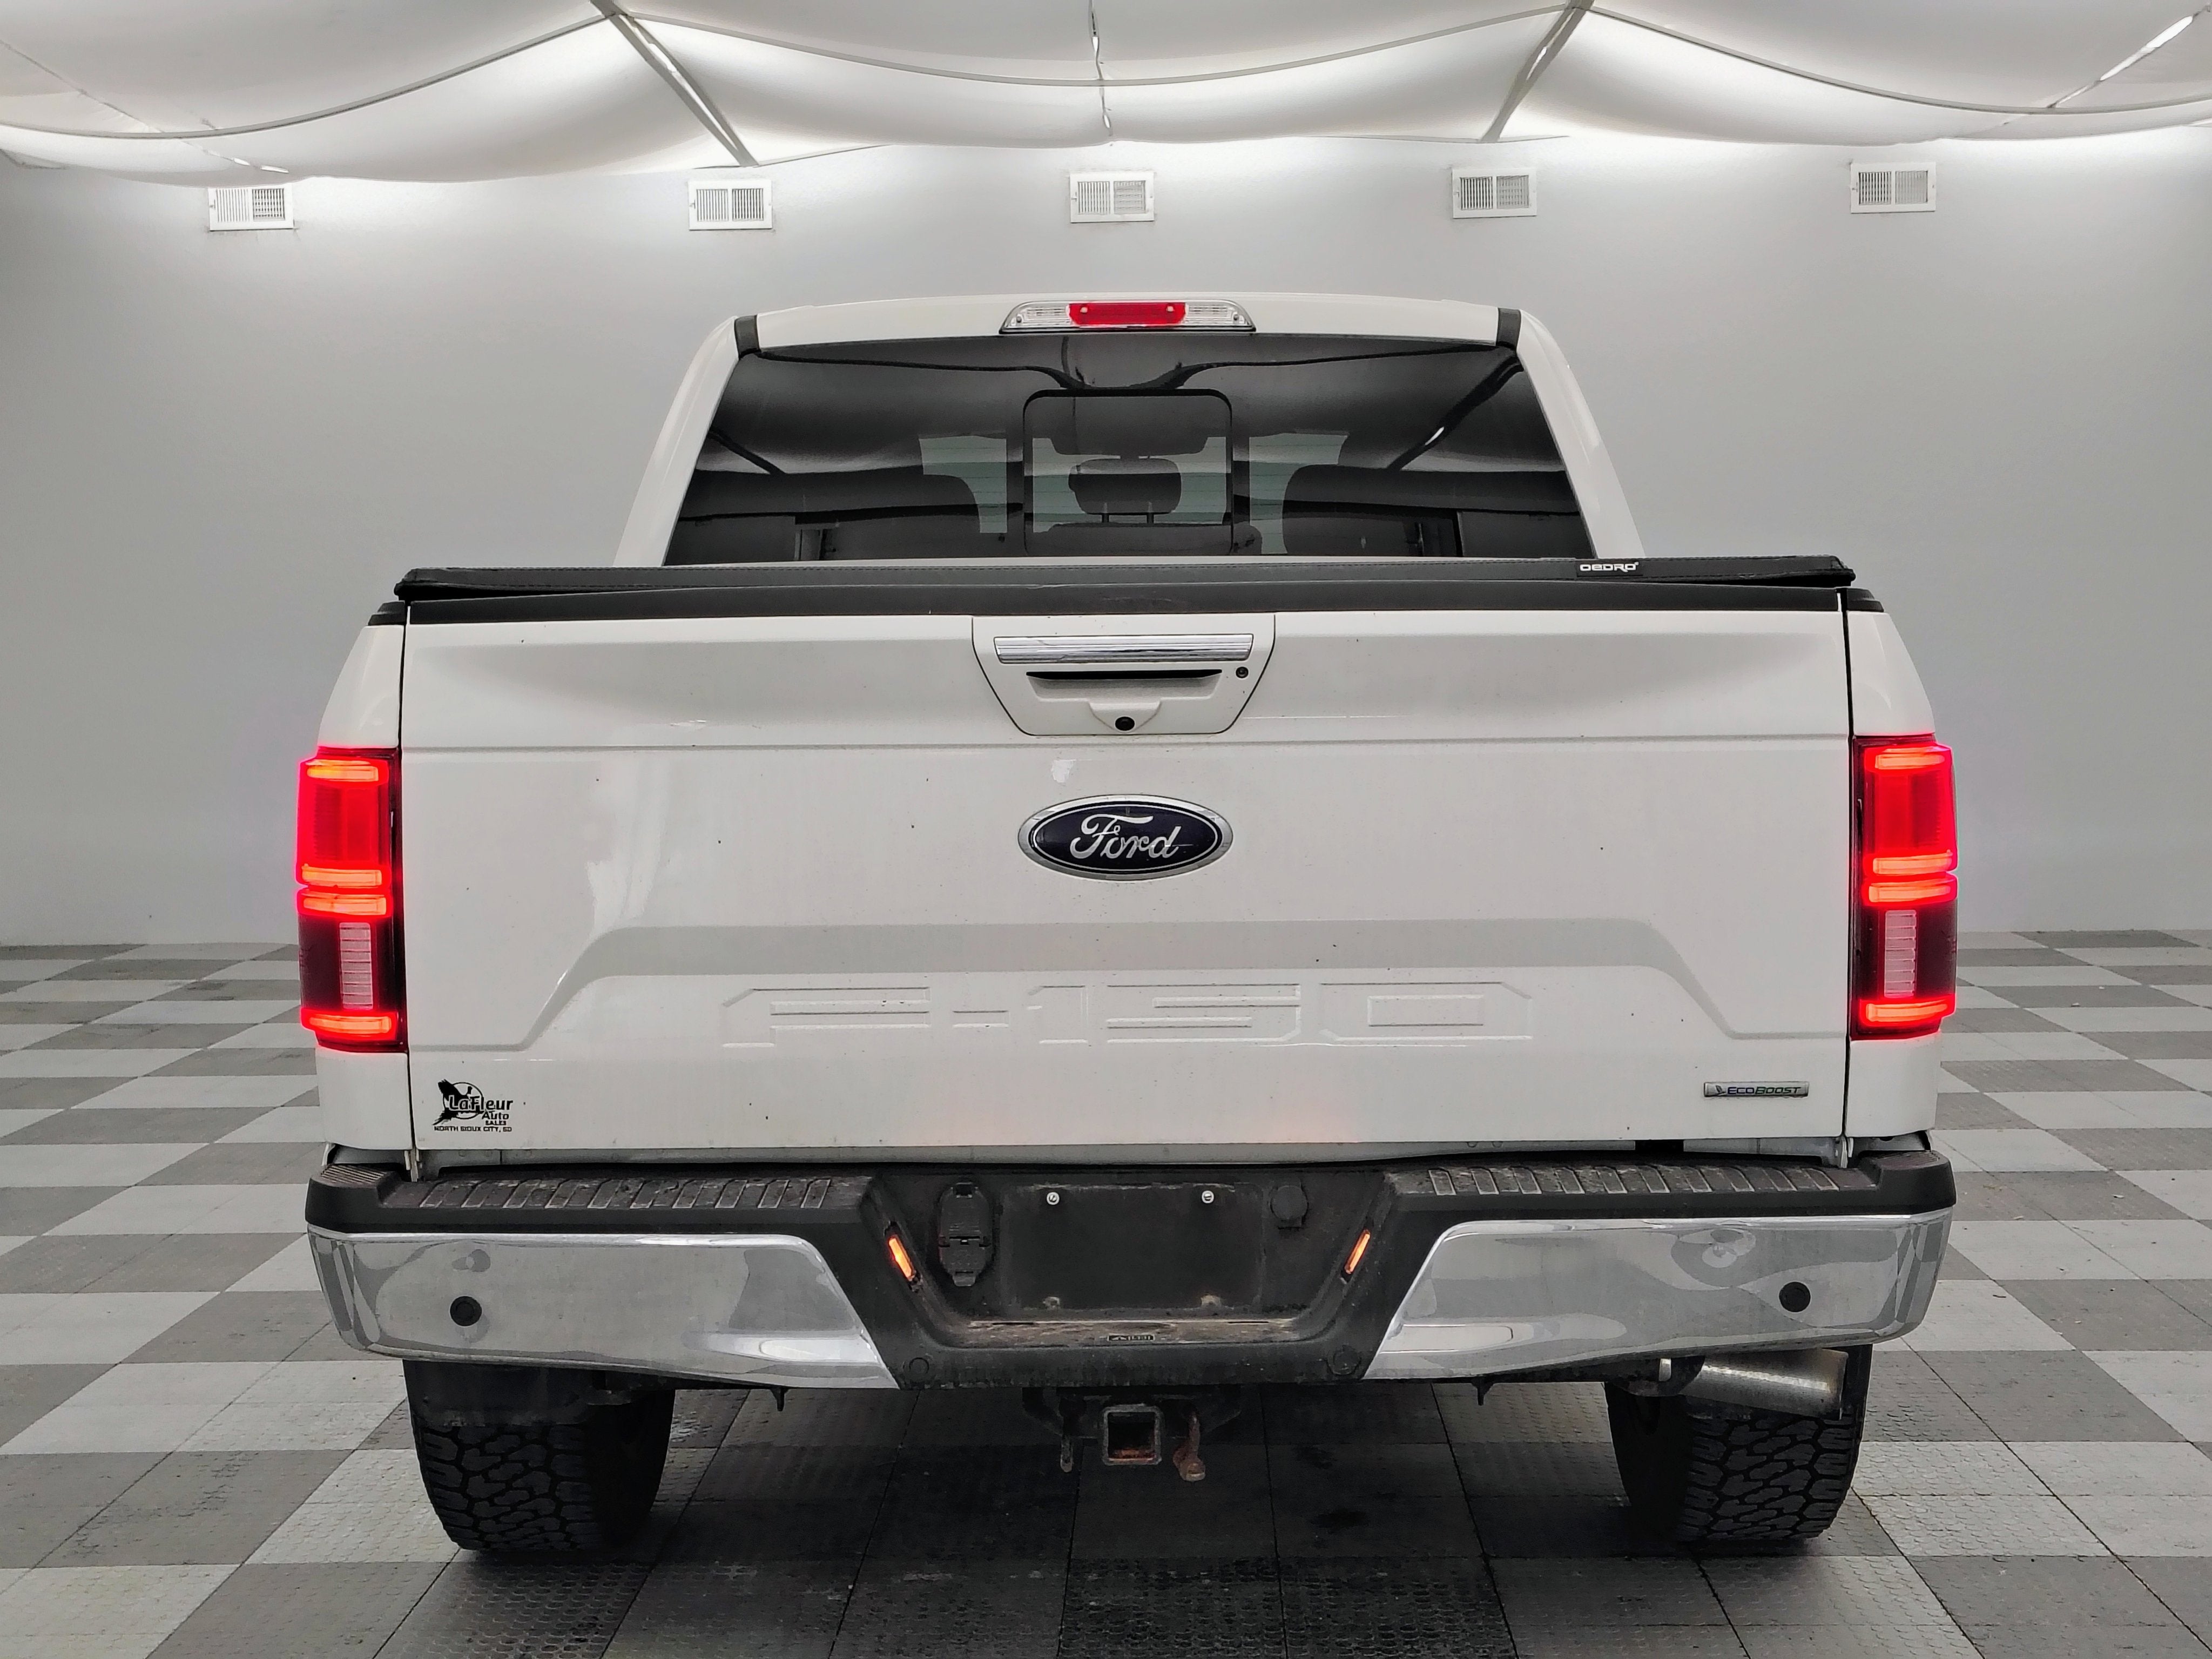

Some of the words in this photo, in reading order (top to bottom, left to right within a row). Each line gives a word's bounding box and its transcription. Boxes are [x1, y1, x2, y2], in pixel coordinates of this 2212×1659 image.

[1580, 563, 1636, 572] OEDRO
[1070, 813, 1183, 859] Ford
[449, 1095, 513, 1110] LaFleur
[482, 1111, 509, 1120] Auto
